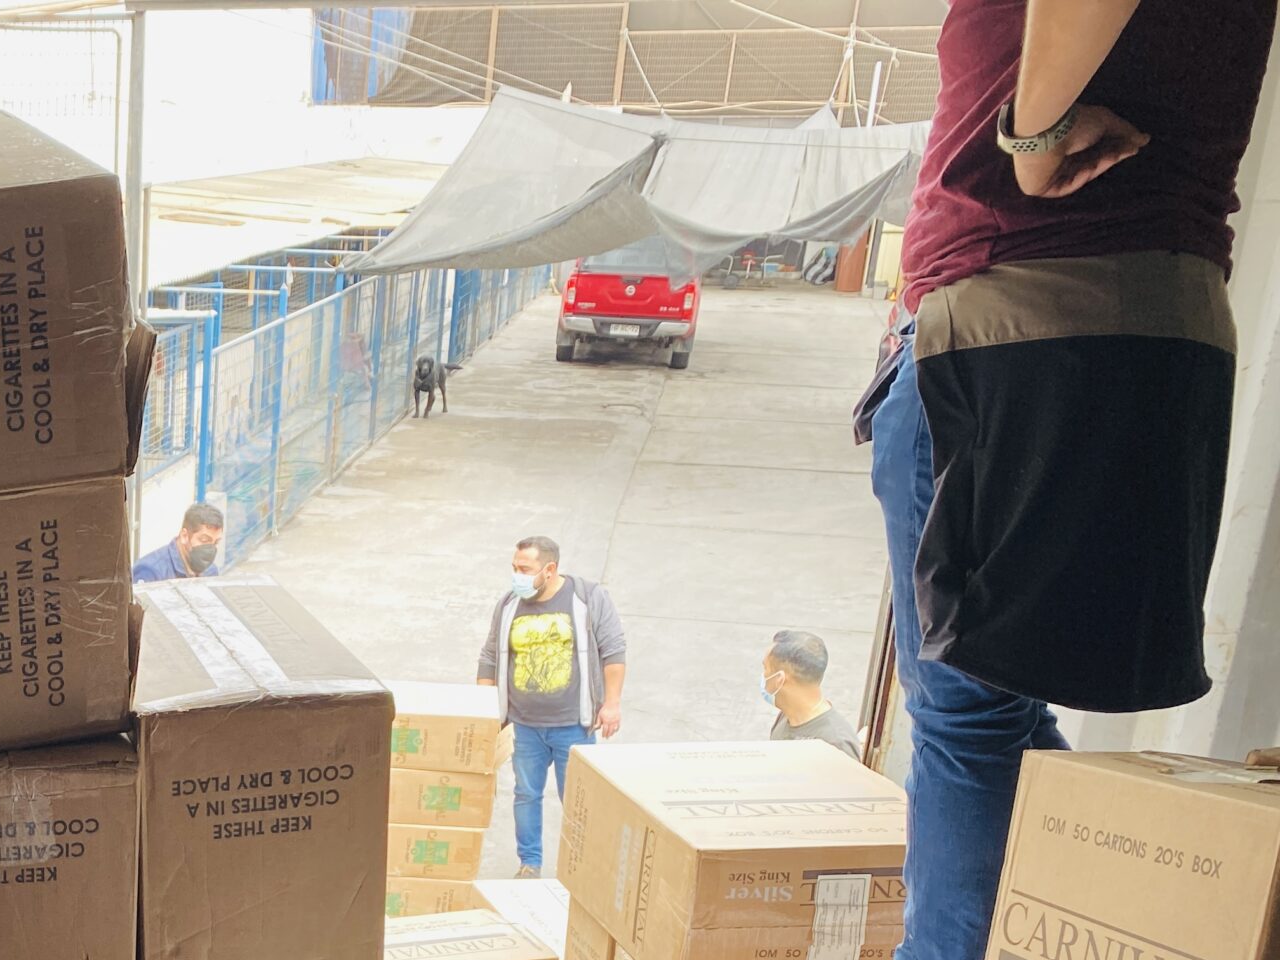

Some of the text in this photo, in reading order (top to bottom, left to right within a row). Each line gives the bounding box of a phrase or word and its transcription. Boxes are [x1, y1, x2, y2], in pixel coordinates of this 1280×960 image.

[25, 225, 53, 445] COOL & DRY PLACE
[1, 304, 24, 433] CIGARETTES
[15, 538, 40, 697] CIGARETTES IN A
[40, 519, 65, 707] COOL & DRY PLACE
[171, 763, 355, 797] COOL & DRY PLACE
[186, 788, 340, 819] CIGARETTES IN A
[26, 821, 36, 836] &
[45, 818, 99, 836] COOL
[213, 815, 313, 840] KEEP THESE
[1072, 825, 1224, 881] 50 CARTONS 20'S BOX
[15, 866, 57, 883] KEEP
[728, 870, 791, 884] King Size
[725, 885, 793, 903] Silver
[785, 949, 801, 959] 50
